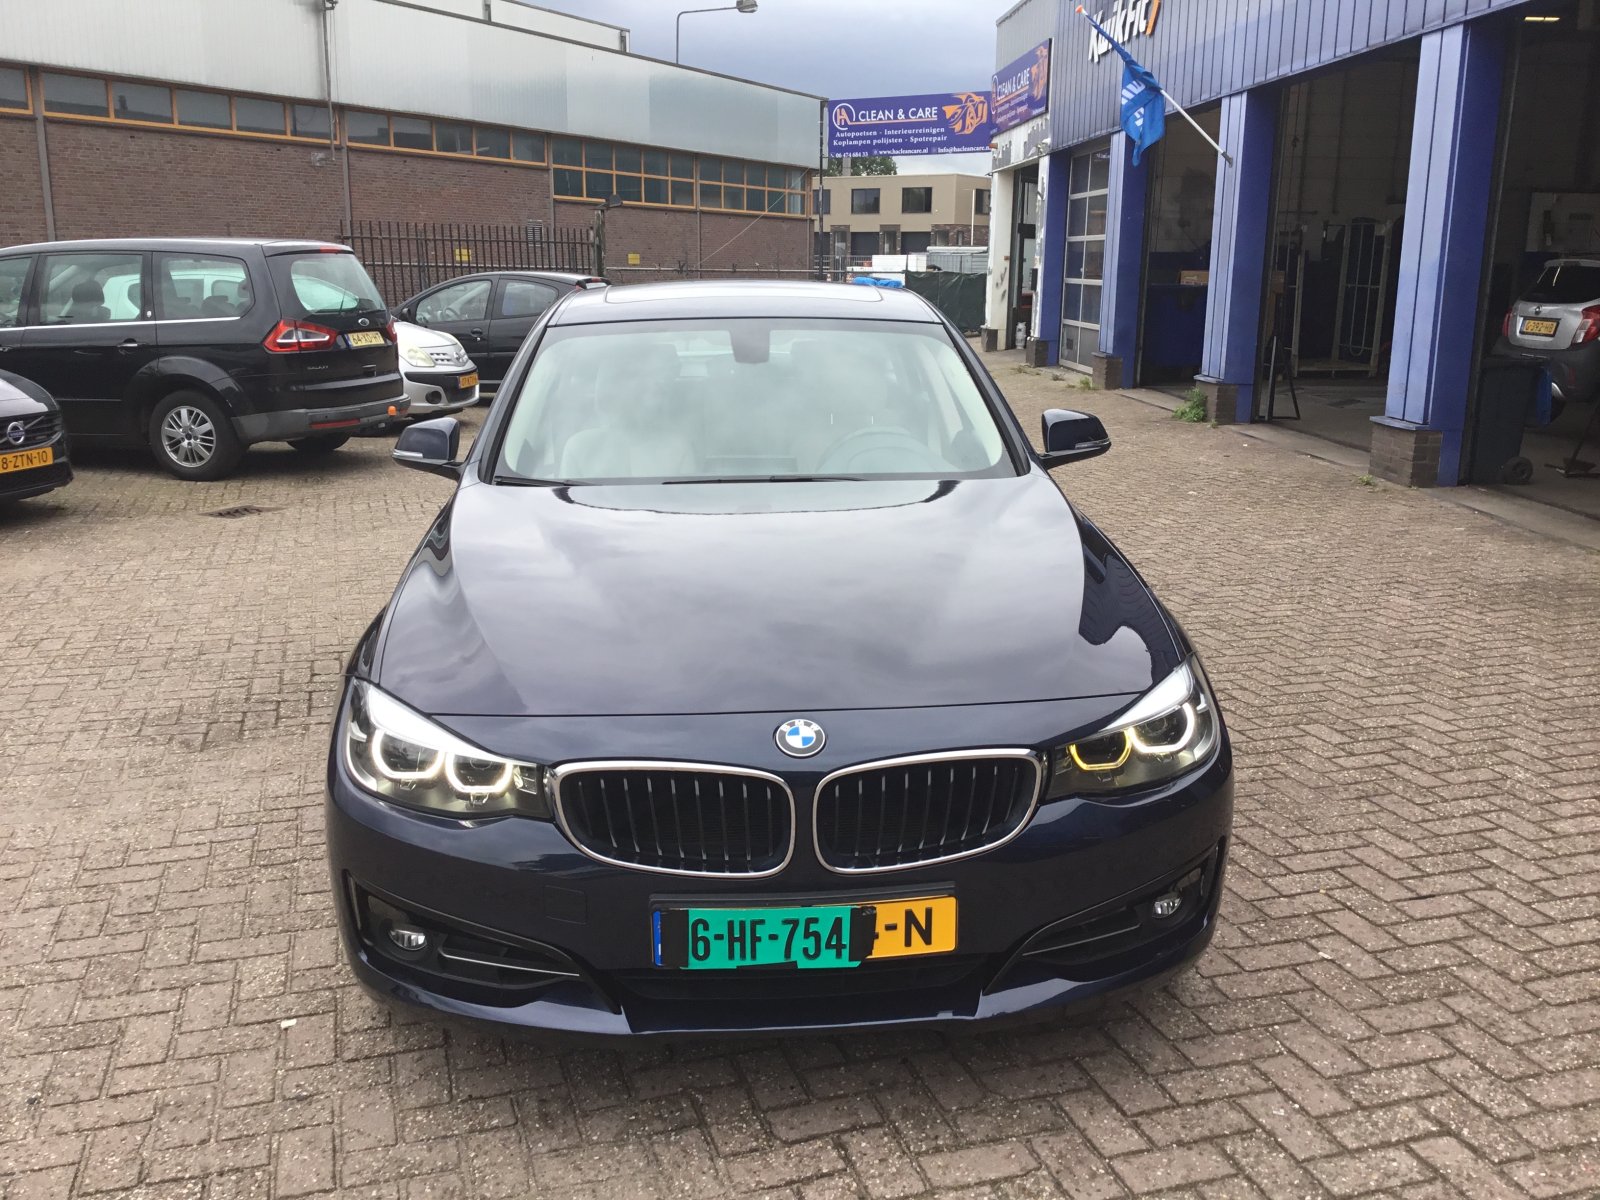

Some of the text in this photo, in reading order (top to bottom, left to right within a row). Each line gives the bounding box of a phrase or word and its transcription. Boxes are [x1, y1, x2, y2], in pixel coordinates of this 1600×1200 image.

[1017, 67, 1030, 90] CARE
[858, 109, 894, 122] CLEAN
[897, 108, 906, 120] &
[908, 106, 938, 119] CARE
[835, 130, 878, 138] Autopoetsen
[884, 126, 945, 136] Interieurreinigen
[833, 138, 871, 147] Koplampen
[873, 136, 903, 146] polijsten
[909, 135, 948, 143] Spotrepair
[691, 917, 847, 961] 6-HF-754
